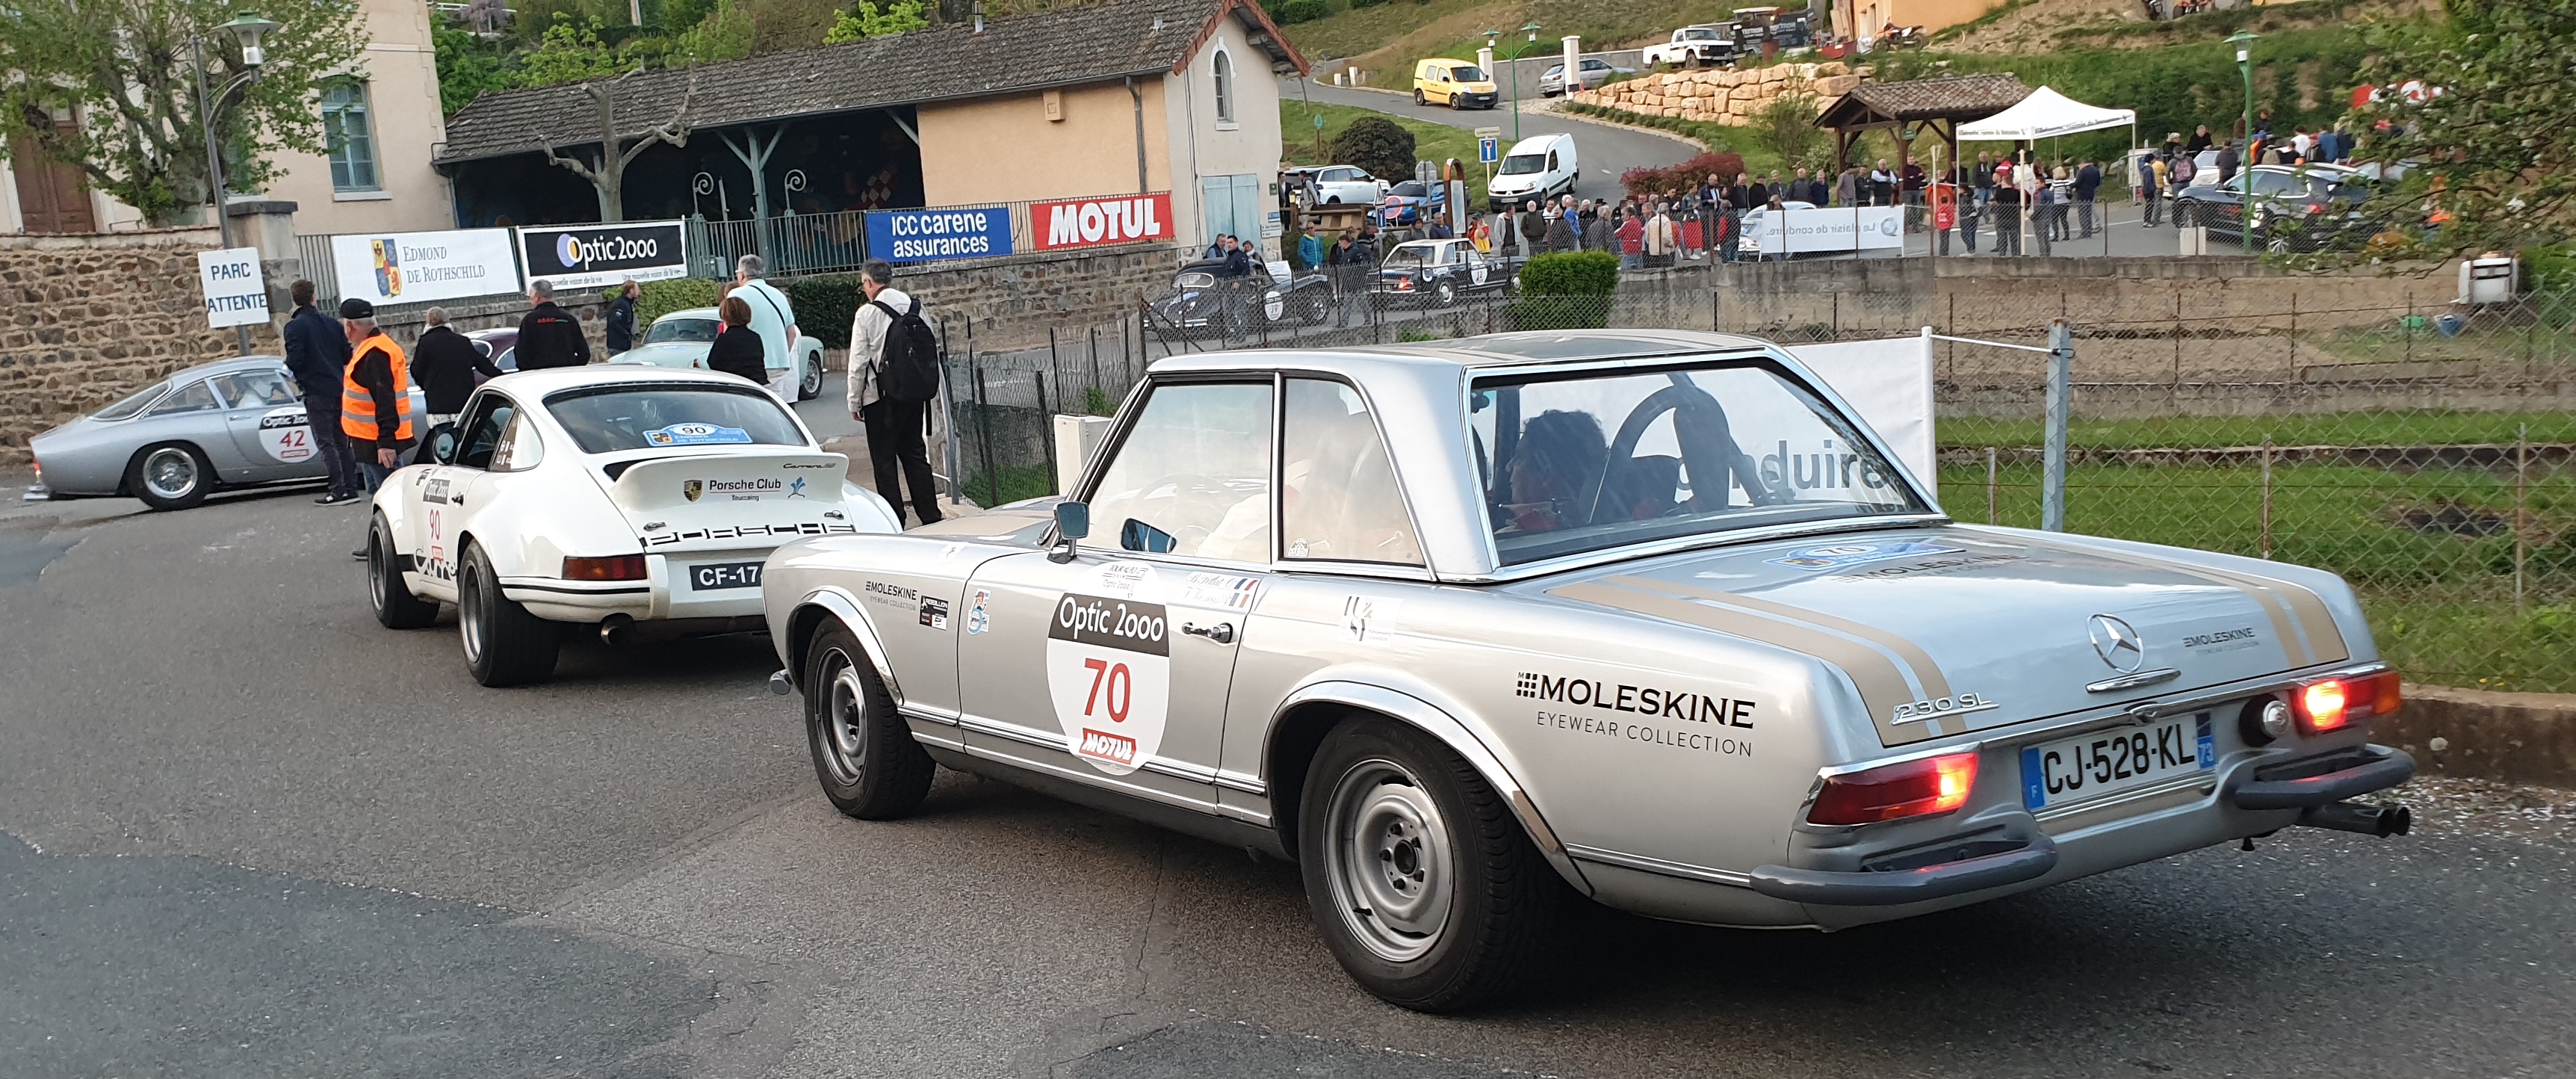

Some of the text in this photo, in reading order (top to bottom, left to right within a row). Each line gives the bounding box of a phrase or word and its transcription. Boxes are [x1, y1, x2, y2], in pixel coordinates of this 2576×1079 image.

[891, 212, 987, 236] ICC carene
[1048, 198, 1160, 245] MOTUL
[403, 246, 447, 262] EDMOND
[894, 235, 988, 258] assurances
[211, 262, 250, 280] PARC
[422, 265, 485, 282] ROTHSCHILD
[207, 294, 268, 312] ATTENTE
[279, 430, 306, 447] 42
[710, 478, 781, 491] Porsche Club
[430, 509, 440, 540] 90
[1814, 546, 1866, 554] 70
[870, 582, 917, 600] MOLESKINE
[1059, 596, 1164, 641] Optic 2000
[2190, 628, 2255, 646] MOLESKINE
[1085, 658, 1130, 723] 70
[1539, 674, 1756, 729] MOLESKINE
[1896, 693, 1992, 719] 230 SL
[1537, 711, 1752, 757] EYEWEAR COLLECTION
[1083, 732, 1133, 761] MOTUL
[2199, 742, 2214, 764] 73
[2031, 785, 2037, 798] F
